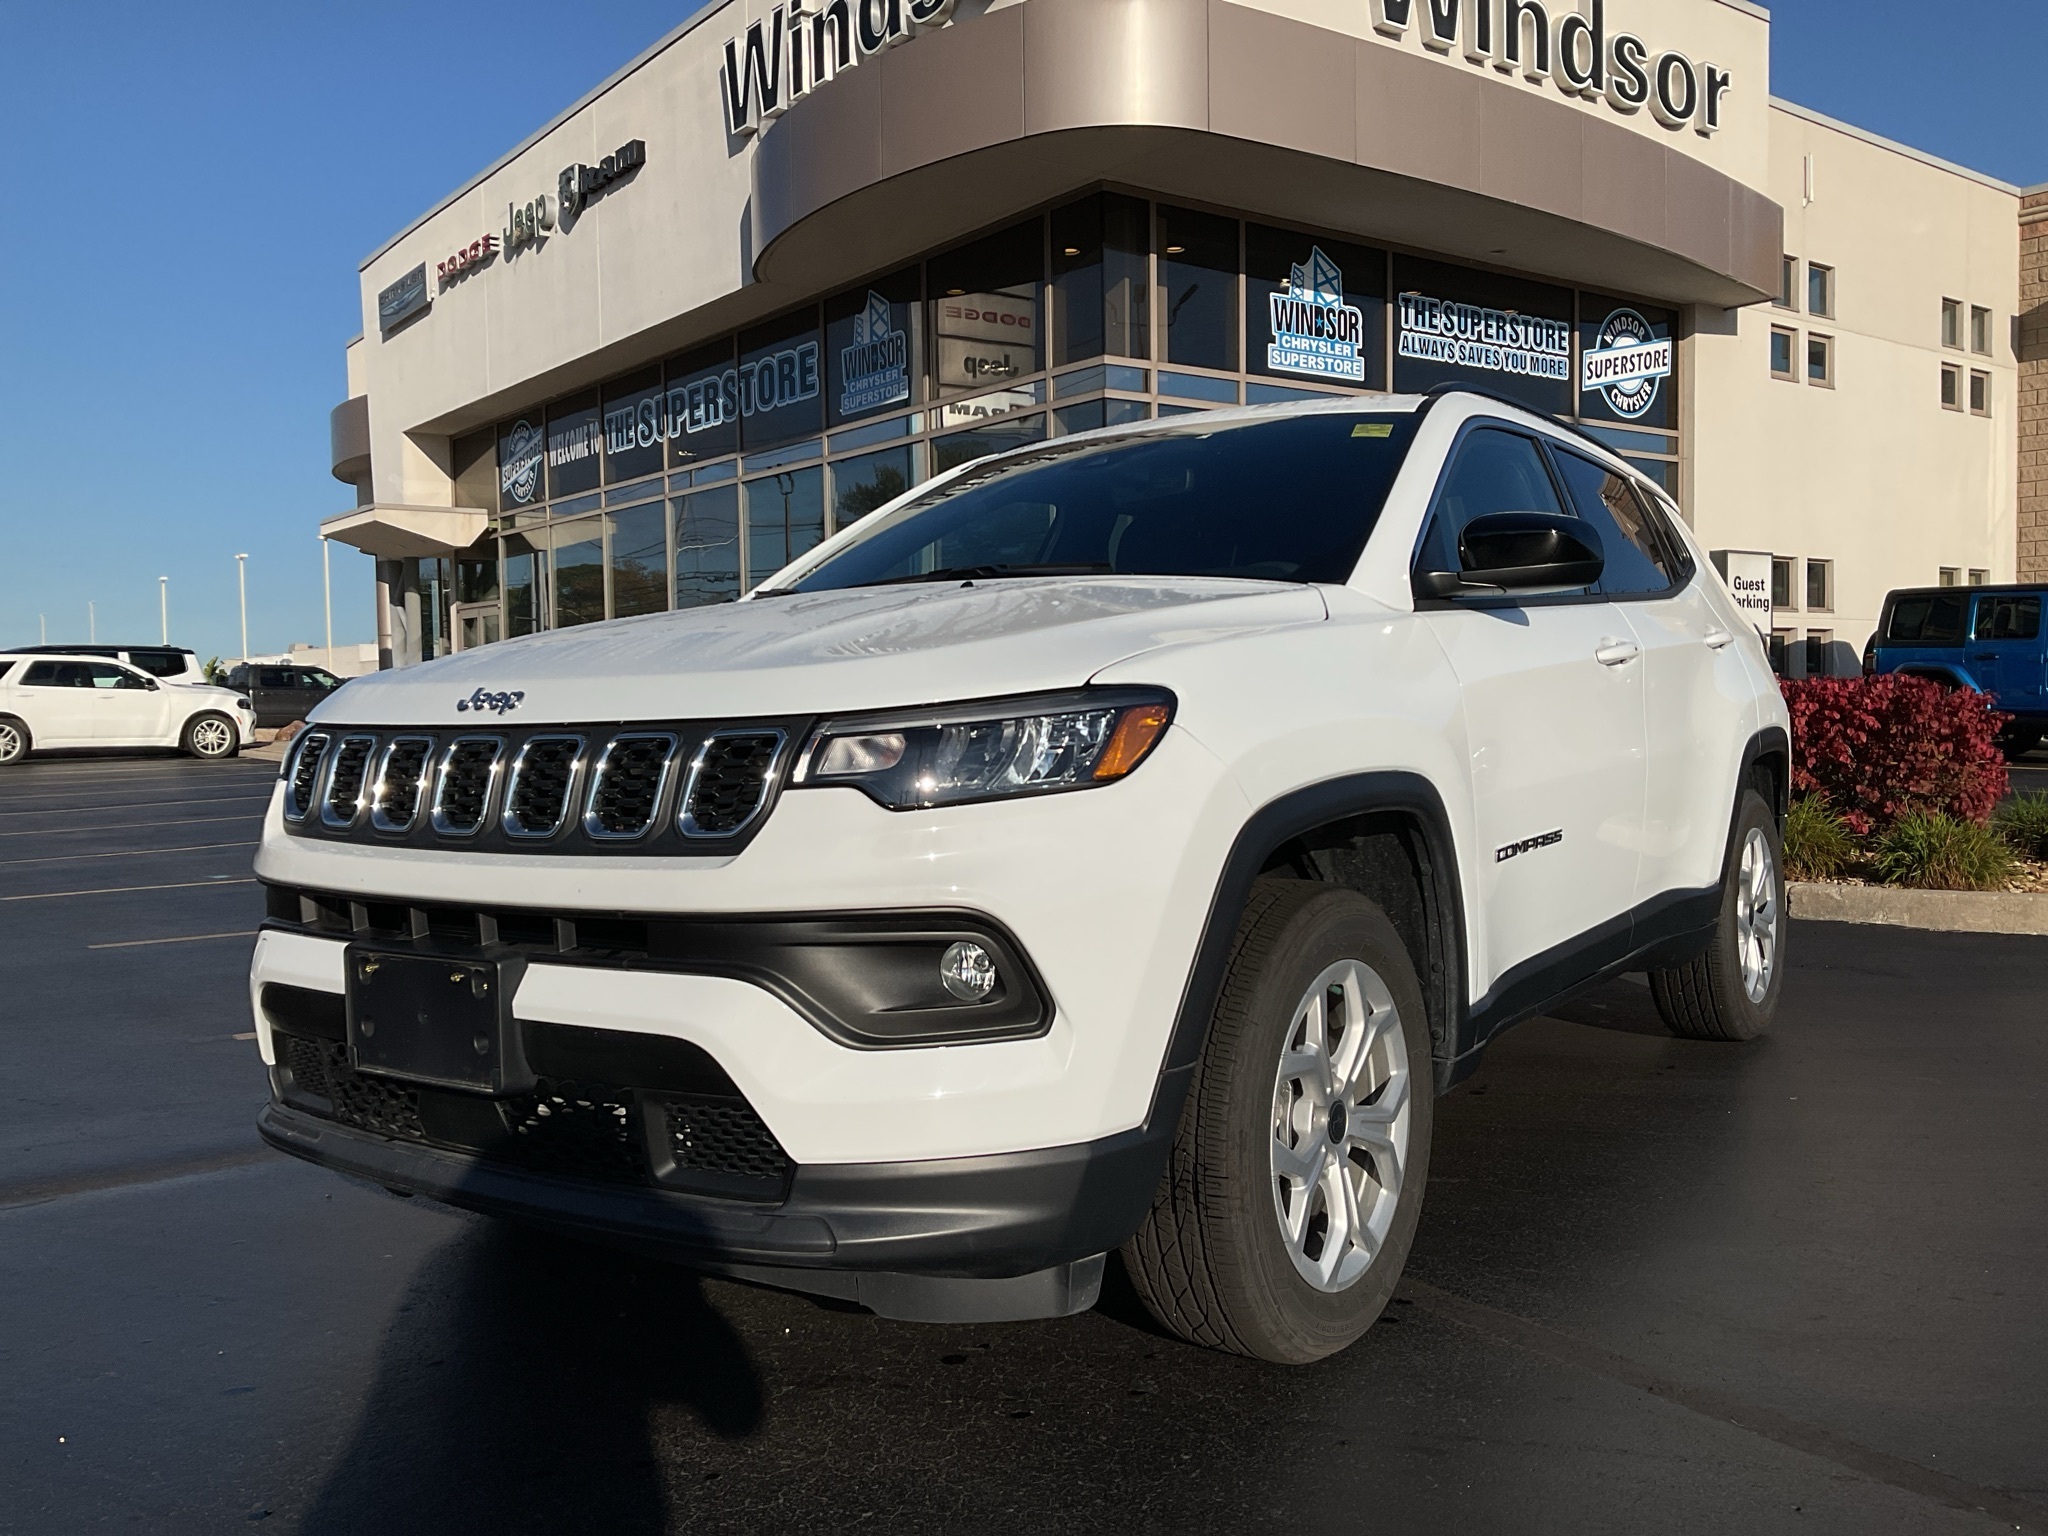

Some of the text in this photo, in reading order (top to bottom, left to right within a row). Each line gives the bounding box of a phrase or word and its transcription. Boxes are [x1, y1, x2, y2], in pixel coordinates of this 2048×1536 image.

[580, 138, 646, 193] RAM
[503, 194, 554, 246] Jeep
[437, 233, 499, 281] DODGE
[1273, 298, 1359, 343] WINDSOR
[1400, 294, 1568, 355] THE SUPERSTORE
[1603, 316, 1646, 344] WINDSOR
[844, 335, 906, 380] WINDSOR
[1272, 350, 1361, 375] SUPERSTORE
[1281, 335, 1352, 357] CHRYSLER
[1400, 333, 1568, 378] ALWAYS SAVES YOU MORE!
[849, 369, 899, 393] CHRYSLER
[1586, 348, 1668, 381] SUPERSTORE
[605, 341, 819, 454] THE SUPERSTORE
[844, 381, 907, 410] SUPERSTORE
[1611, 381, 1653, 411] CHRYSLER
[548, 421, 600, 467] WELCOME TO
[503, 440, 543, 484] SUPERSTORE
[514, 470, 535, 498] CHRYSLER
[1733, 575, 1765, 591] Guest
[1731, 593, 1770, 613] arking
[456, 687, 525, 716] Jeep
[1495, 828, 1563, 864] COMPASS
